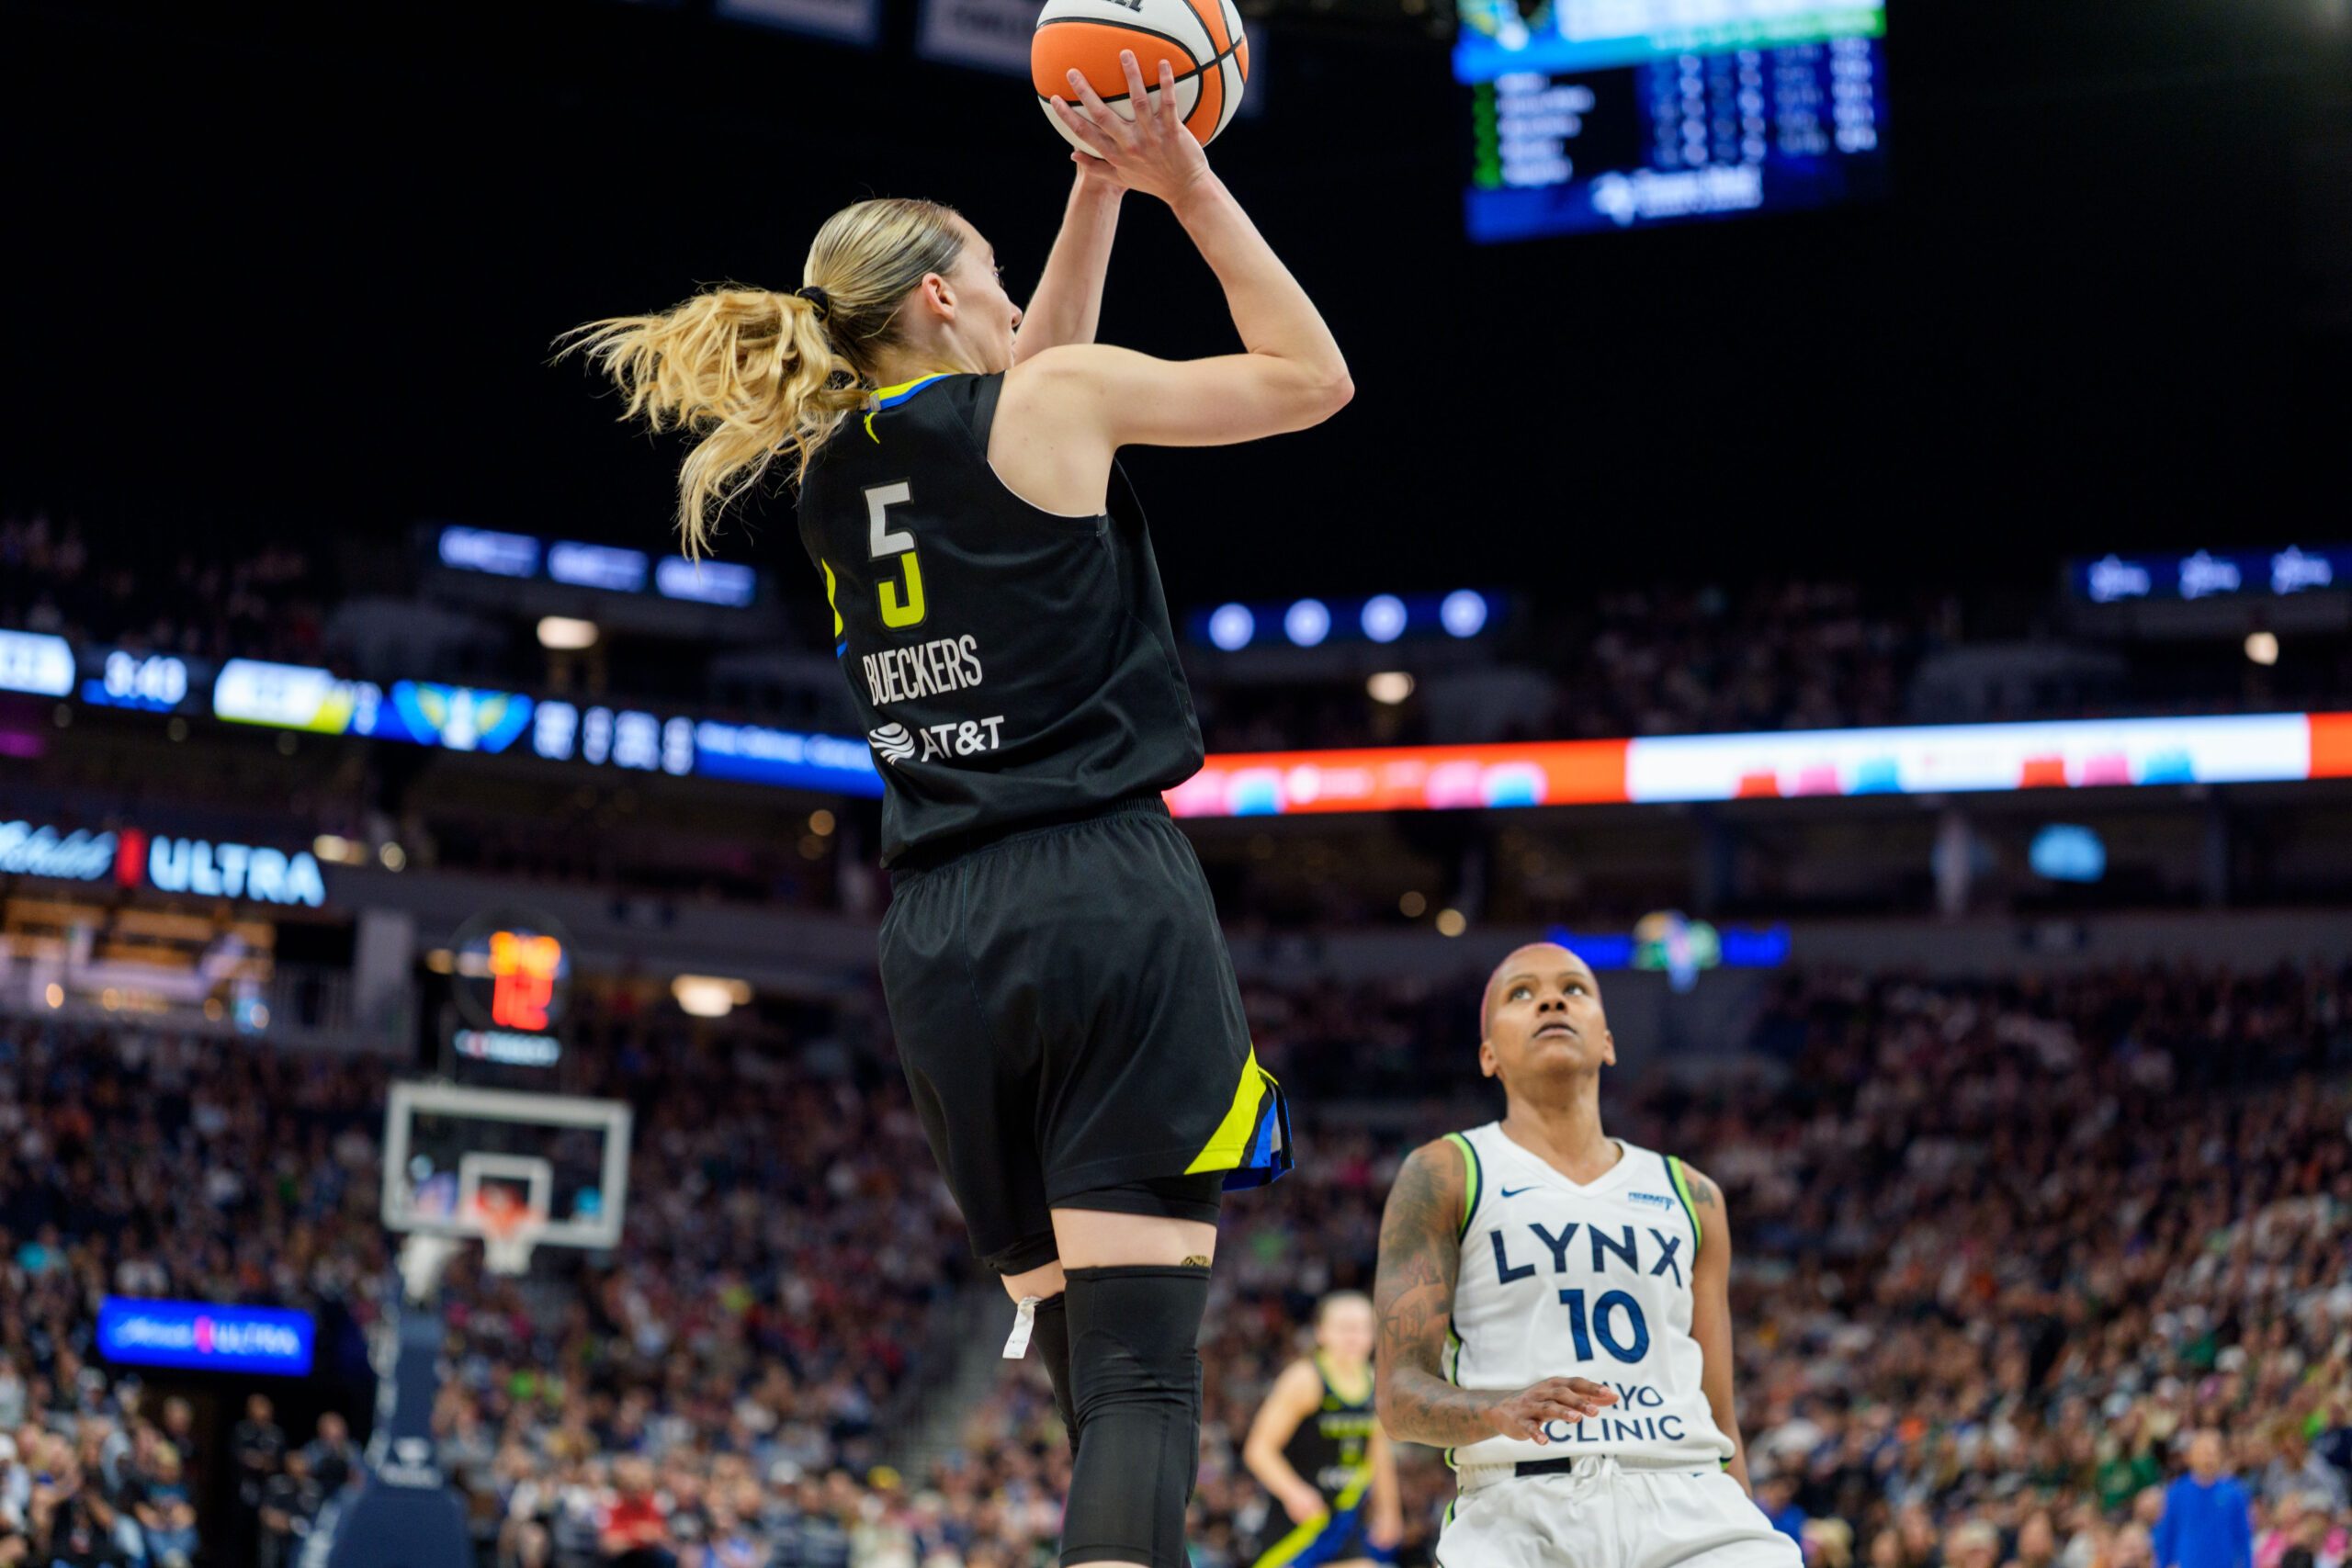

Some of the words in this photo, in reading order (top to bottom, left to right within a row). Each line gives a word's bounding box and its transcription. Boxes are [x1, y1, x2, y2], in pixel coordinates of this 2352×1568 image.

[864, 479, 927, 630] 5
[863, 634, 983, 706] BUECKERS
[921, 715, 1004, 762] AT&T
[150, 835, 326, 908] ULTRA
[1490, 1223, 1683, 1289] LYNX
[1558, 1288, 1650, 1364] 10
[1544, 1415, 1686, 1443] CLINIC
